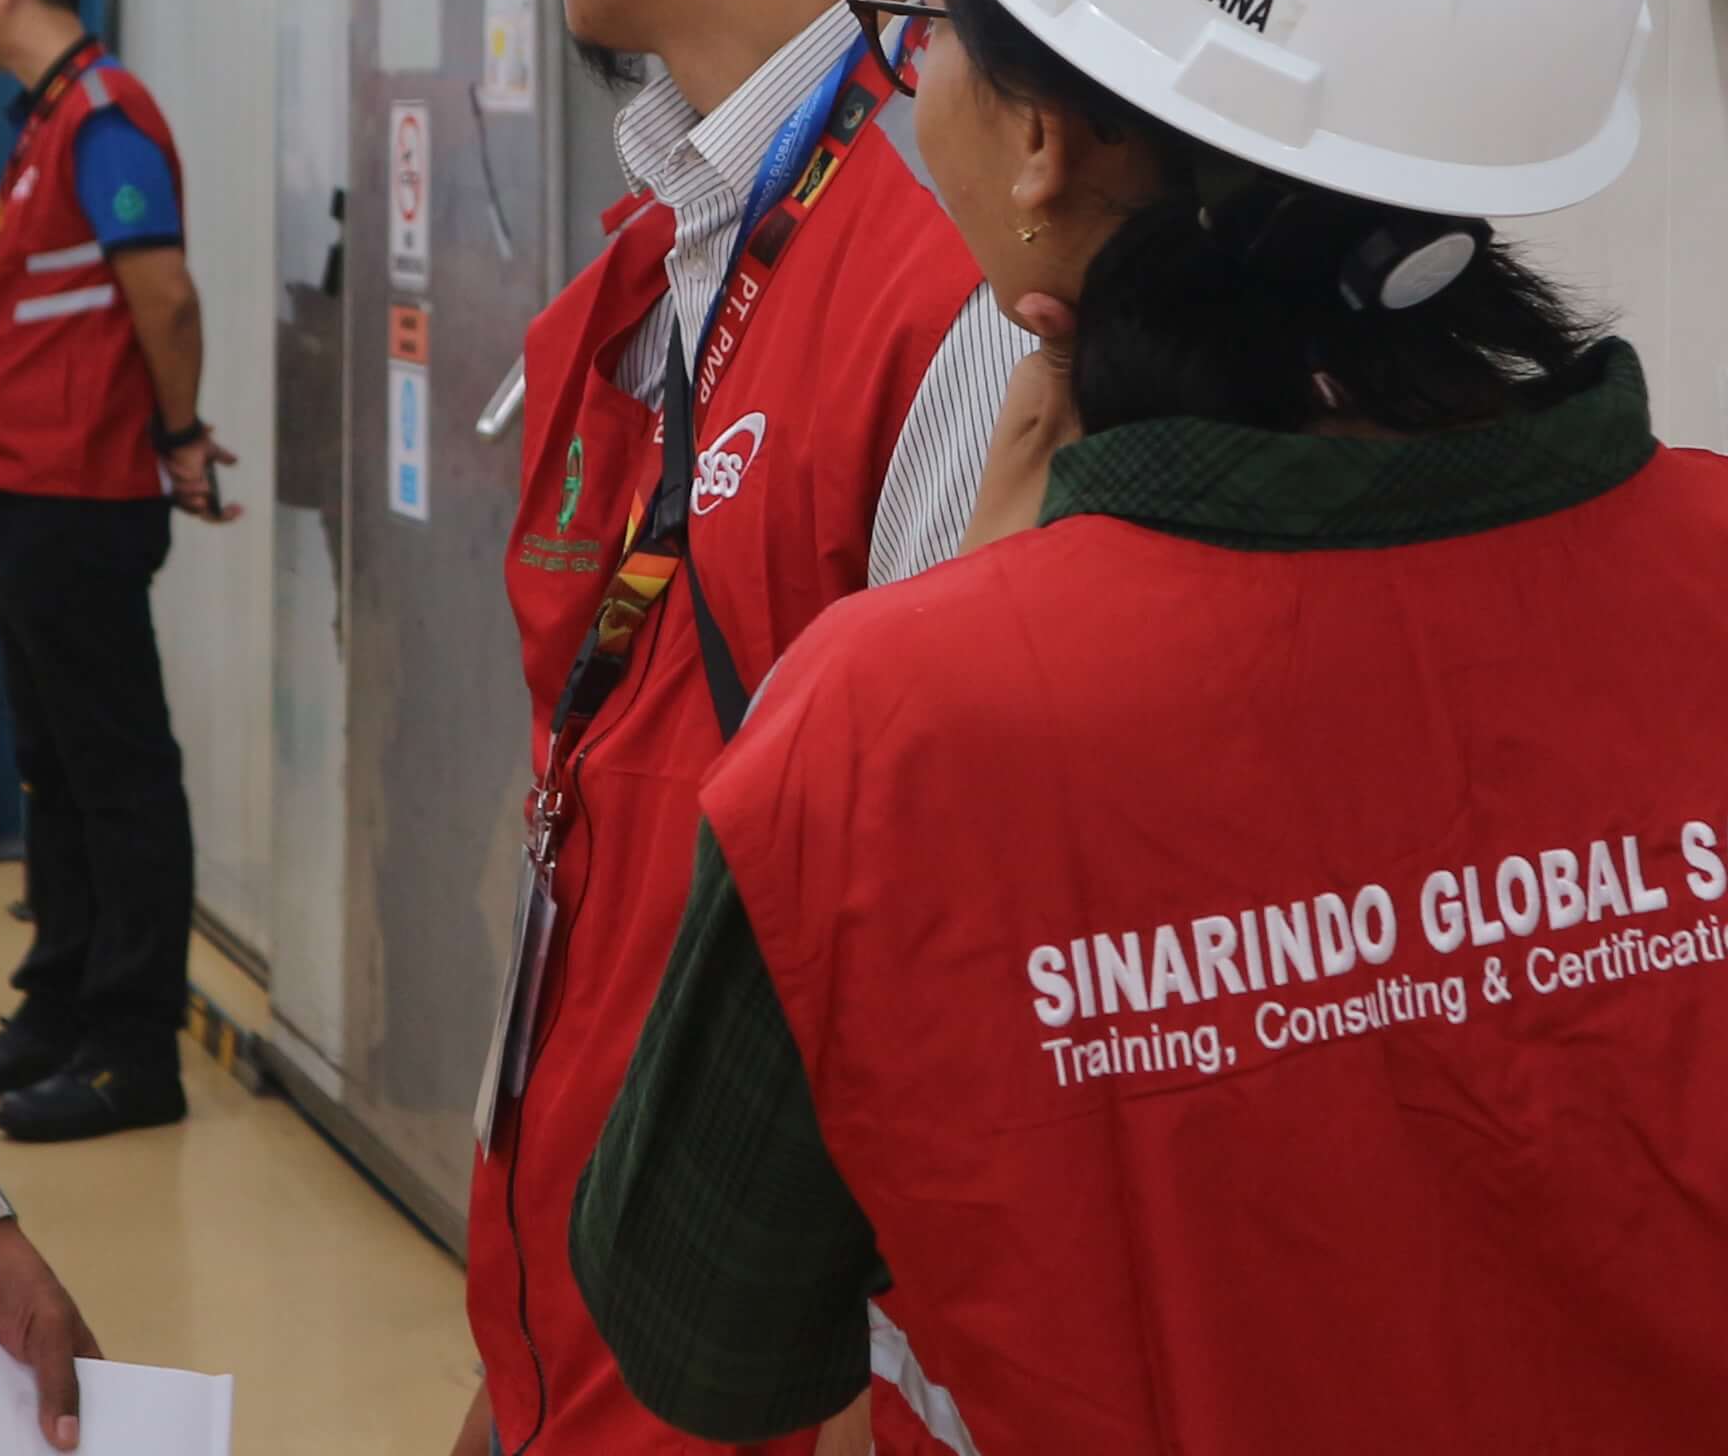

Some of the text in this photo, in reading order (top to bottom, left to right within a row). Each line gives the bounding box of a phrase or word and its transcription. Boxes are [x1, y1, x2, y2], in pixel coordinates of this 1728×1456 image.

[698, 270, 759, 404] PT. PMP
[1027, 883, 1398, 1028] SINARINDO
[1419, 834, 1669, 955] GLOBAL
[1041, 1019, 1239, 1089] Training,
[1254, 967, 1469, 1050] Consulting
[1481, 955, 1512, 1003] &
